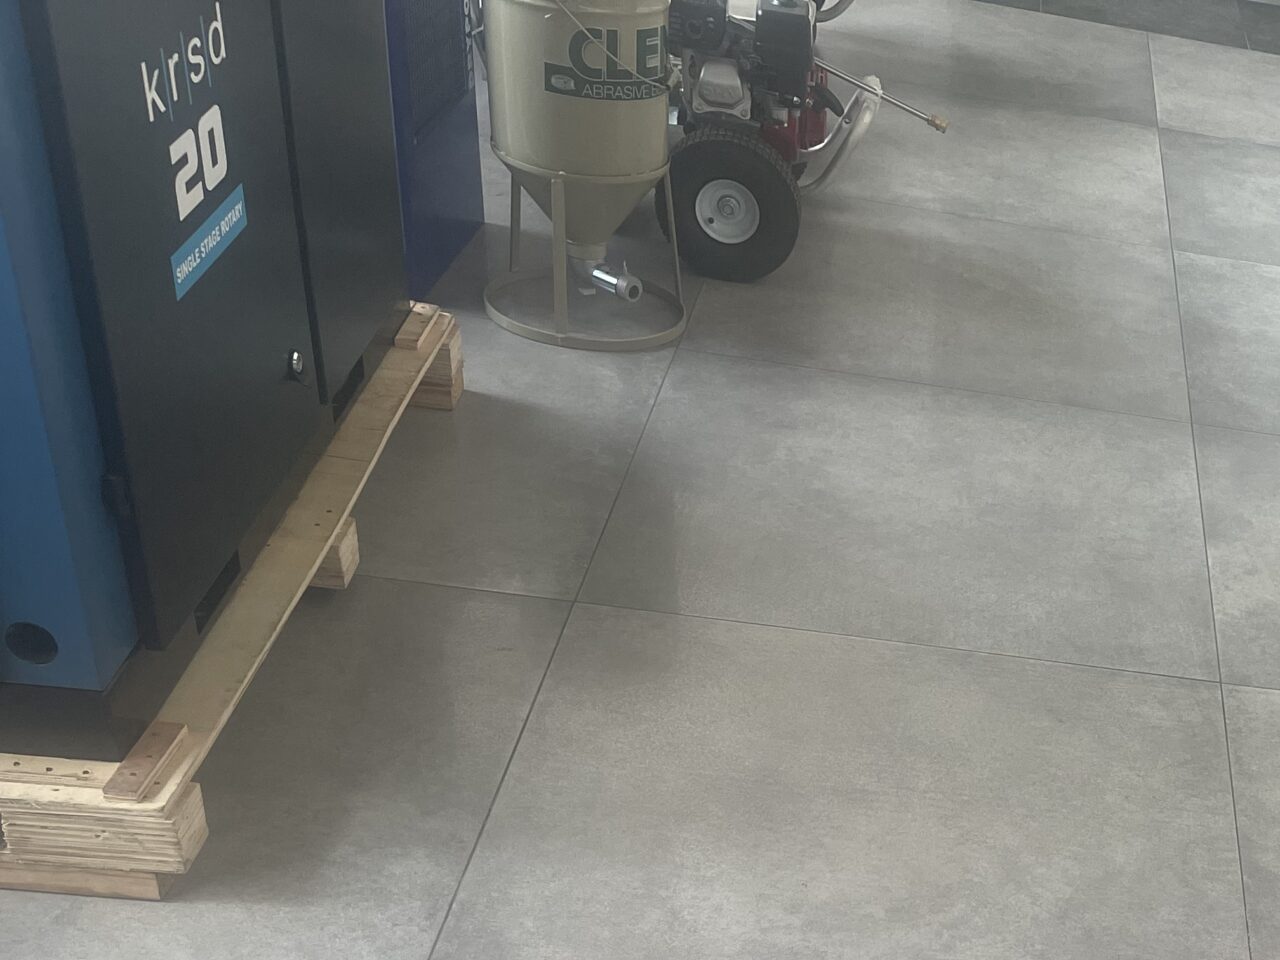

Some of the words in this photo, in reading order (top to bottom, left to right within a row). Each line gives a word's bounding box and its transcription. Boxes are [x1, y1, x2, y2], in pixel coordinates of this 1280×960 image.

[567, 25, 667, 81] CLE
[581, 83, 650, 99] ABRASIVE
[169, 104, 228, 222] 20
[176, 247, 201, 283] SINGLE
[200, 225, 221, 258] STAGE
[220, 200, 243, 237] ROTARY
